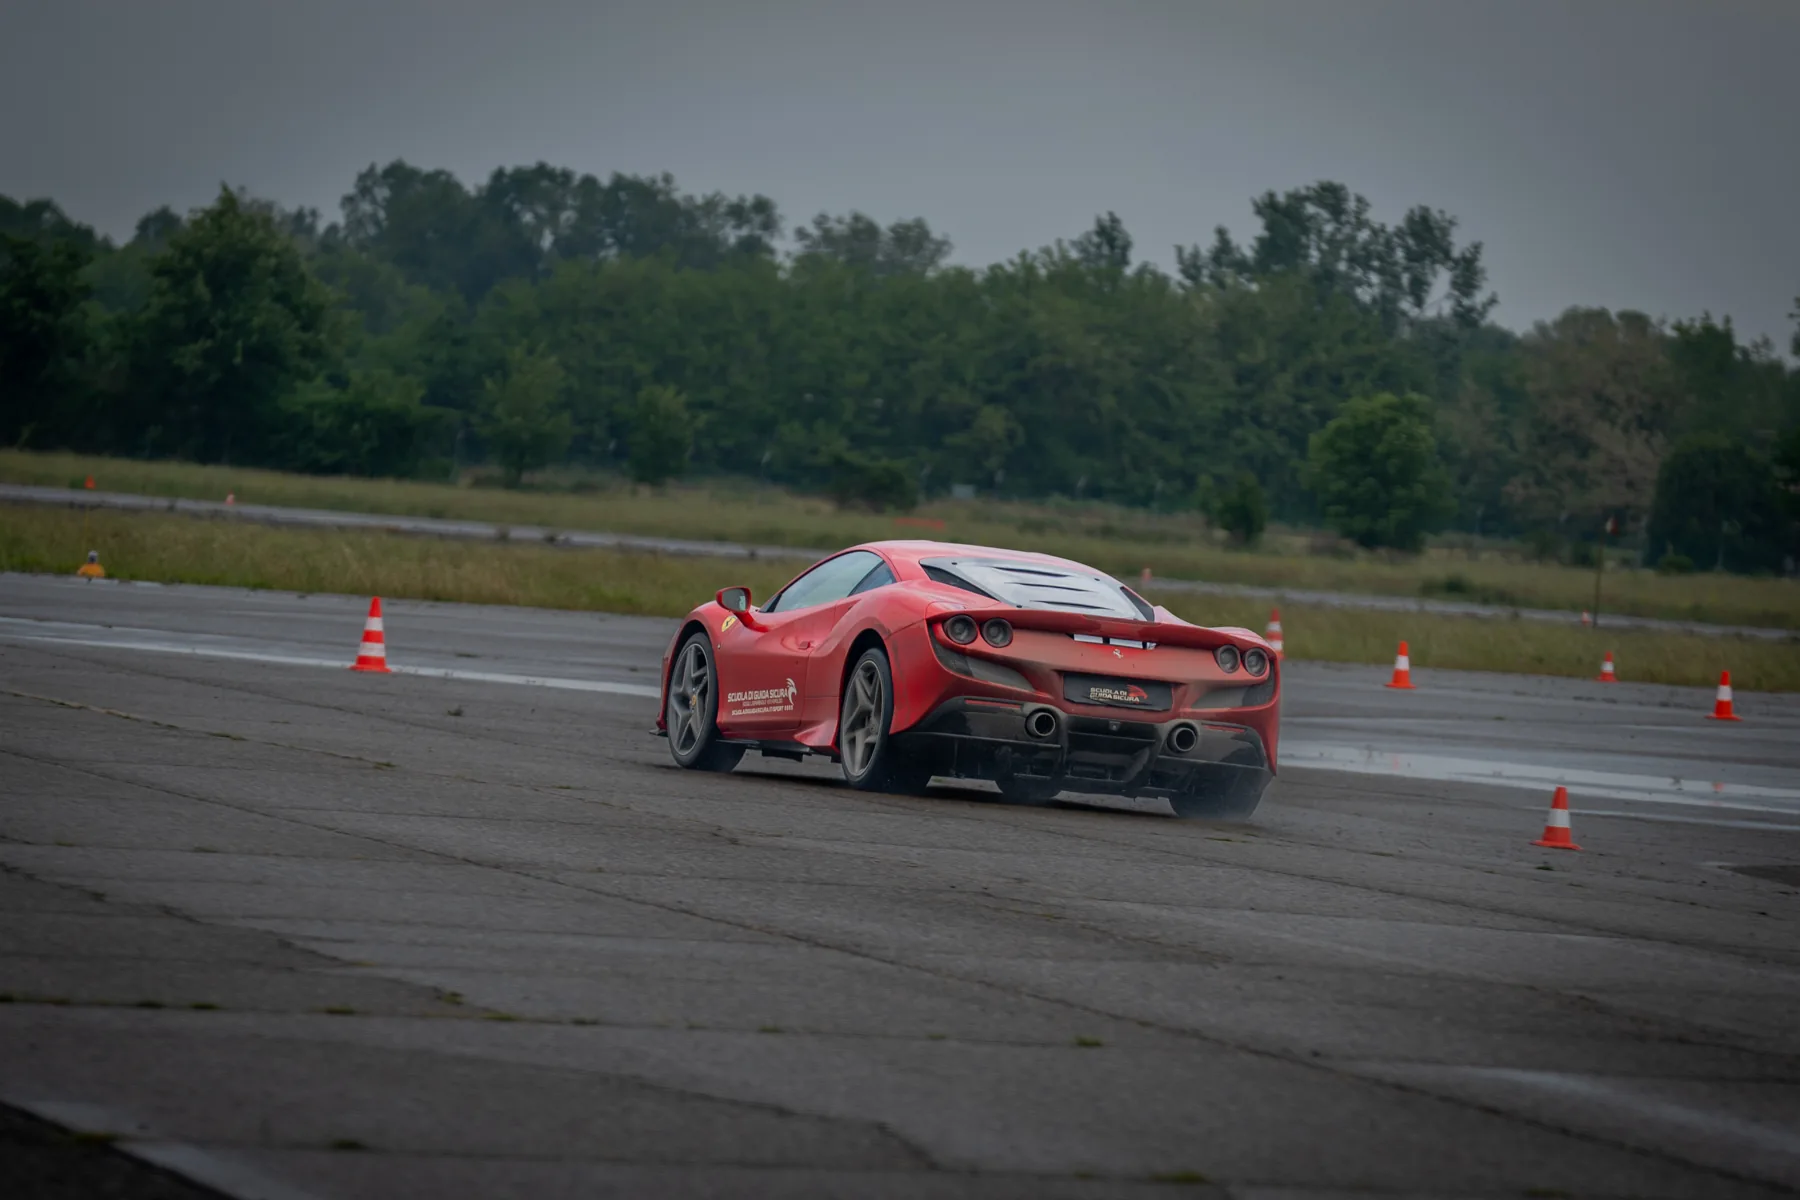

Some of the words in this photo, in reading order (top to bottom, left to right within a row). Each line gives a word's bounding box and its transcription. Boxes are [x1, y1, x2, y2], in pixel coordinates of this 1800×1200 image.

[728, 692, 748, 702] SCUOLA
[748, 691, 753, 700] DI
[754, 690, 769, 700] GUIDA
[769, 688, 788, 698] SICURA
